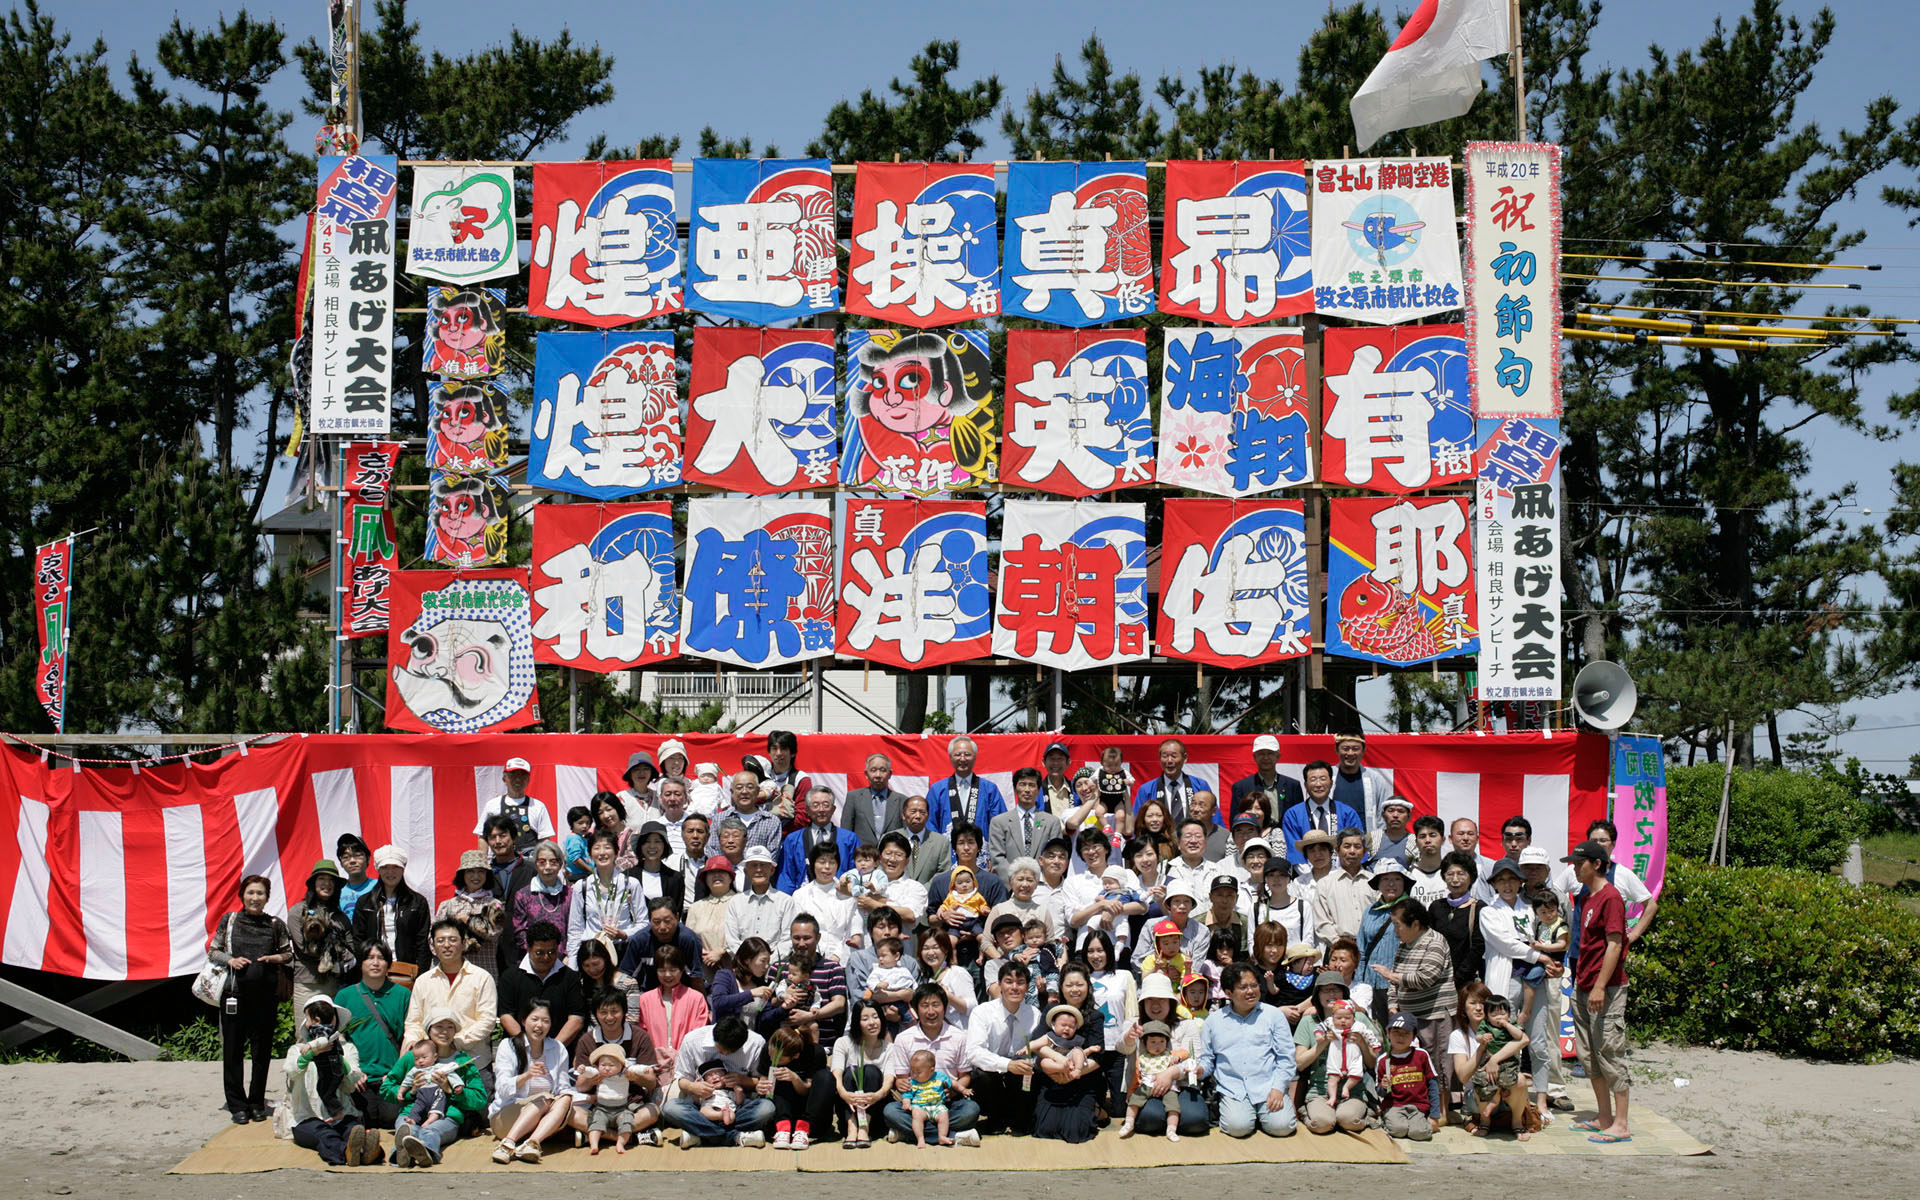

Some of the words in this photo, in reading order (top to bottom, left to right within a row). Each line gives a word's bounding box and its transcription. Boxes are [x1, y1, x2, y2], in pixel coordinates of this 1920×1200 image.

[1316, 164, 1373, 193] 富士山
[1377, 162, 1450, 190] 静岡空港
[1485, 161, 1540, 179] 平成20年
[412, 247, 501, 262] 牧之原市観光協会
[325, 256, 341, 288] 会場
[1348, 268, 1424, 284] 牧之原市
[344, 219, 391, 413] 凧あげ大会
[322, 296, 341, 410] 相良サンビーチ
[318, 418, 385, 429] 牧之原市観光協会
[1487, 520, 1504, 553] 会場
[1511, 482, 1556, 681] 凧あげ大会
[1488, 561, 1505, 678] 相良サンビーチ
[1486, 686, 1553, 697] 牧之原市観光協会
[1415, 886, 1425, 896] 10
